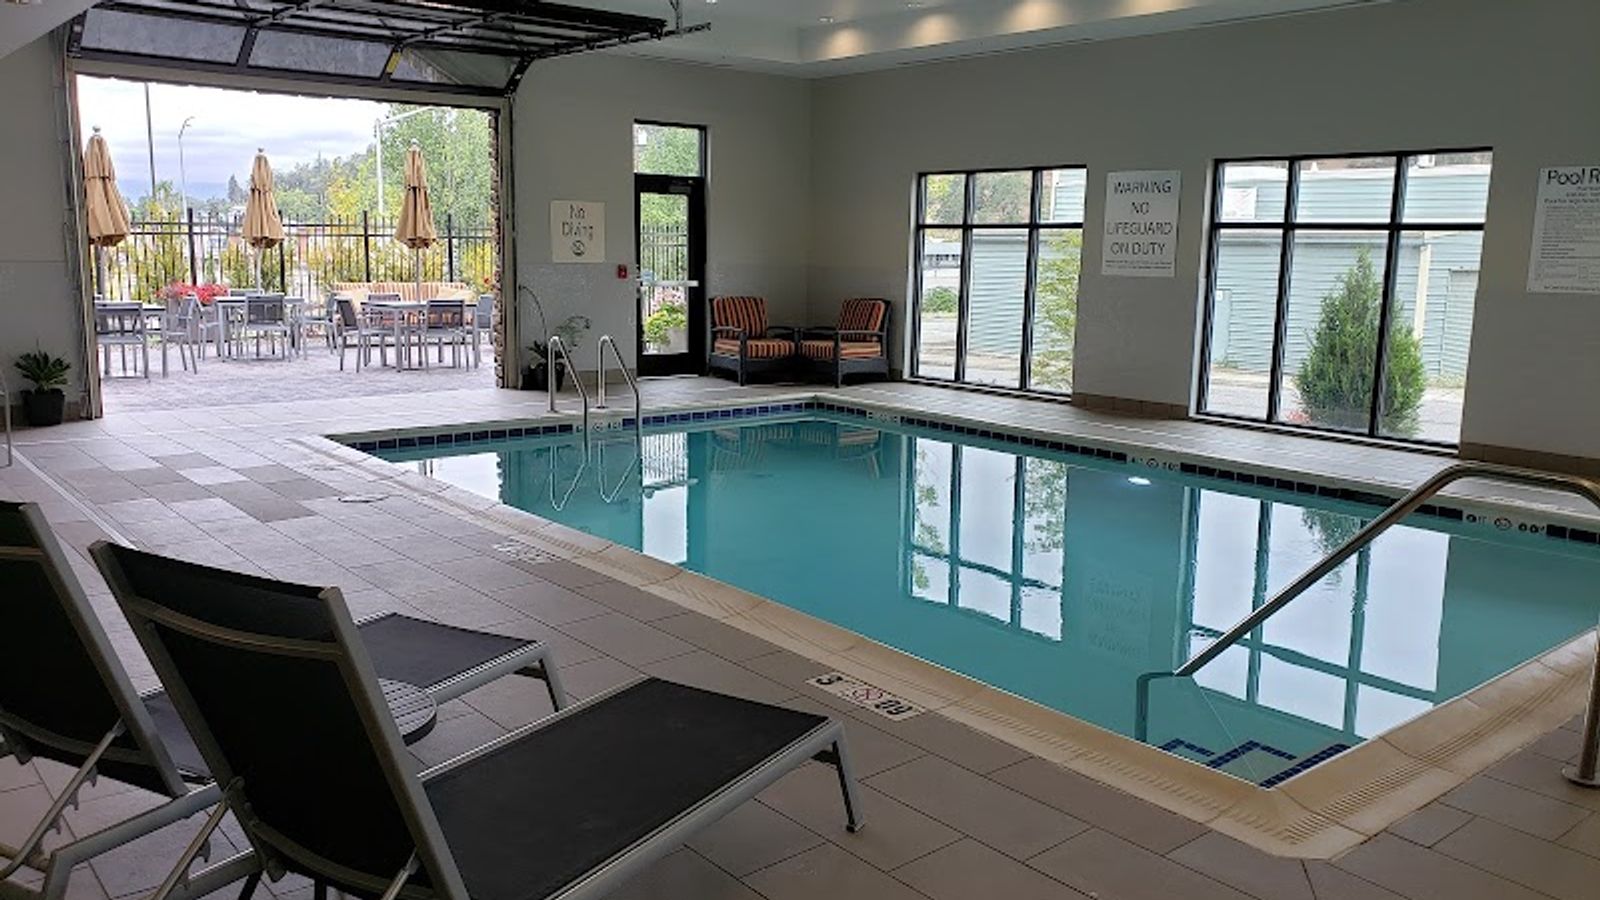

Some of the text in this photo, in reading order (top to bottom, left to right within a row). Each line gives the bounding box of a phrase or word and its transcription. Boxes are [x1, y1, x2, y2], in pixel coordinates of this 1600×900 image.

[1546, 168, 1585, 185] Pool
[1114, 180, 1172, 194] WARNING
[1131, 201, 1150, 215] NO
[1106, 221, 1173, 235] LIFEGUARD
[1110, 241, 1166, 255] ON DUTY
